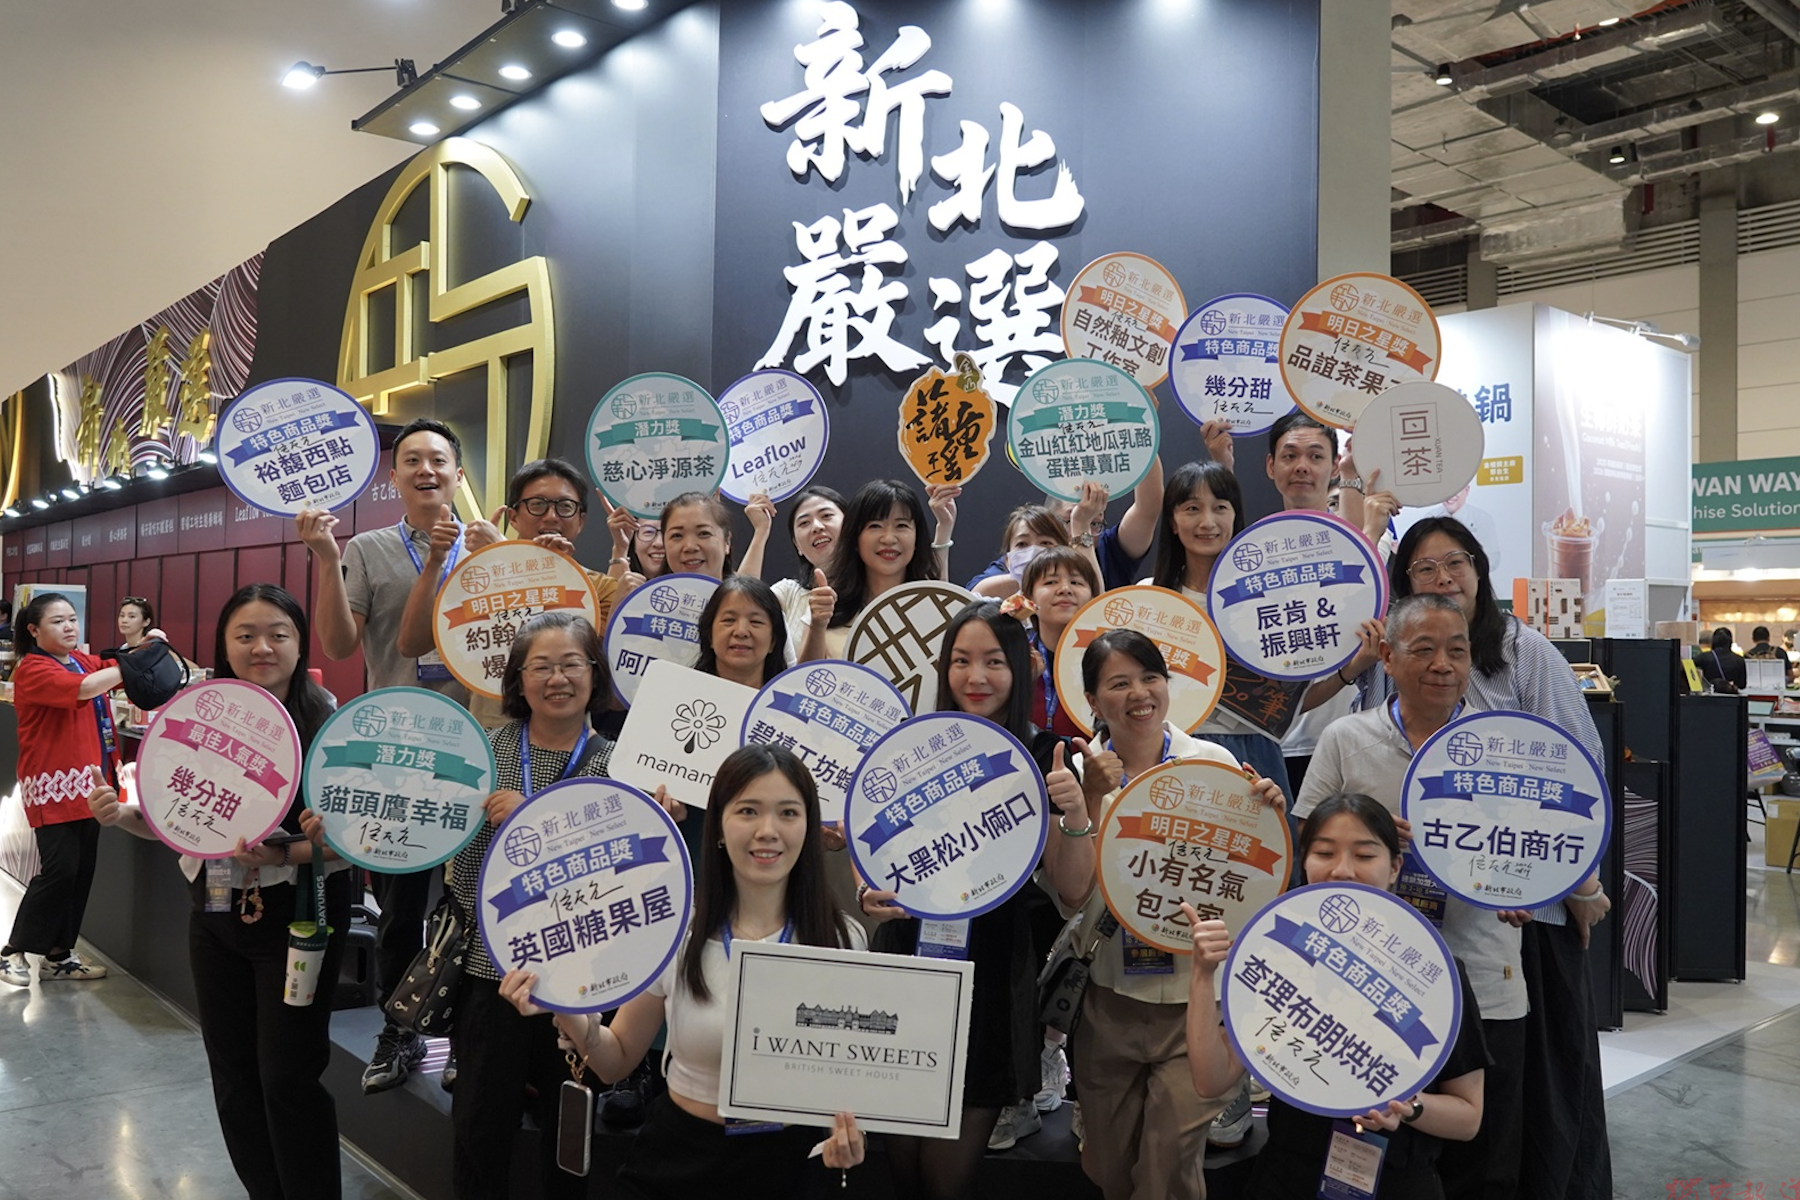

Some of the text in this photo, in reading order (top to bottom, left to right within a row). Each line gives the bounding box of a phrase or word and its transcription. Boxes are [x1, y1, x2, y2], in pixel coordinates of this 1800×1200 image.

[760, 0, 1085, 235] 新北
[1128, 272, 1175, 303] 新北嚴選
[752, 202, 1068, 415] 嚴選
[1100, 290, 1165, 331] 明日之星獎
[1229, 312, 1286, 327] 新北嚴選
[1361, 292, 1423, 324] 新北嚴選
[1073, 308, 1168, 366] 自然釉文創
[1205, 340, 1279, 357] 特色商品獎
[1327, 314, 1410, 357] 明日之星獎
[260, 387, 322, 415] 新北嚴選
[1060, 375, 1119, 390] 新北嚴選
[1205, 375, 1272, 399] 幾分甜
[729, 402, 794, 443] 特色商品獎
[1058, 404, 1106, 421] 潛力獎
[1458, 382, 1512, 424] 鍋
[250, 413, 334, 450] 特色商品獎
[635, 420, 680, 437] 潛力獎
[1018, 427, 1152, 458] 金山紅紅地瓜乳酪
[254, 436, 354, 484] 裕馥西點
[603, 455, 715, 483] 慈心淨源茶
[732, 436, 806, 479] Leaflow
[1047, 452, 1130, 479] 蛋糕專賣店
[277, 464, 353, 505] 麵包店
[1264, 531, 1331, 554] 新北嚴選
[492, 556, 556, 577] 新北嚴選
[1245, 562, 1336, 593] 特色商品獎
[471, 587, 560, 615] 明日之星獎
[1137, 605, 1202, 634] 新北嚴選
[1256, 597, 1337, 631] 辰肯 &
[466, 619, 531, 651] 約翰
[650, 617, 700, 643] 特色商
[1260, 623, 1341, 658] 振興軒
[838, 681, 902, 722] 新北嚴選
[226, 702, 285, 741] 新北嚴選
[390, 711, 464, 735] 新北嚴選
[798, 698, 882, 749] 特色商品獎
[188, 725, 268, 776] 最佳人氣獎
[375, 743, 437, 771] 潛力獎
[892, 723, 966, 774] 新北嚴選
[1486, 736, 1568, 760] 新北嚴選
[167, 765, 242, 822] 幾分甜
[884, 758, 986, 827] 特色商品獎
[1187, 783, 1262, 815] 新北嚴選
[1454, 772, 1564, 804] 特色商品獎
[319, 784, 470, 832] 貓頭鷹幸福
[541, 794, 623, 837] 新北嚴選
[885, 792, 1037, 893] 大黑松小倆口
[1151, 815, 1252, 856] 明日之星獎
[1423, 818, 1585, 864] 古乙伯商行
[521, 838, 634, 897] 特色商品獎
[1128, 850, 1249, 901] 小有名氣
[316, 875, 327, 926] DAYUNGS
[508, 885, 676, 969] 英國糖果屋
[1349, 936, 1426, 998] New Taipei New Select
[1360, 917, 1444, 985] 新北嚴選
[1304, 931, 1410, 1024] 特色商品獎
[1235, 954, 1399, 1098] 查理布朗烘焙
[767, 1036, 840, 1058] WANT
[847, 1044, 938, 1069] SWEETS
[784, 1062, 900, 1081] BRITISH SWEET HOUSE
